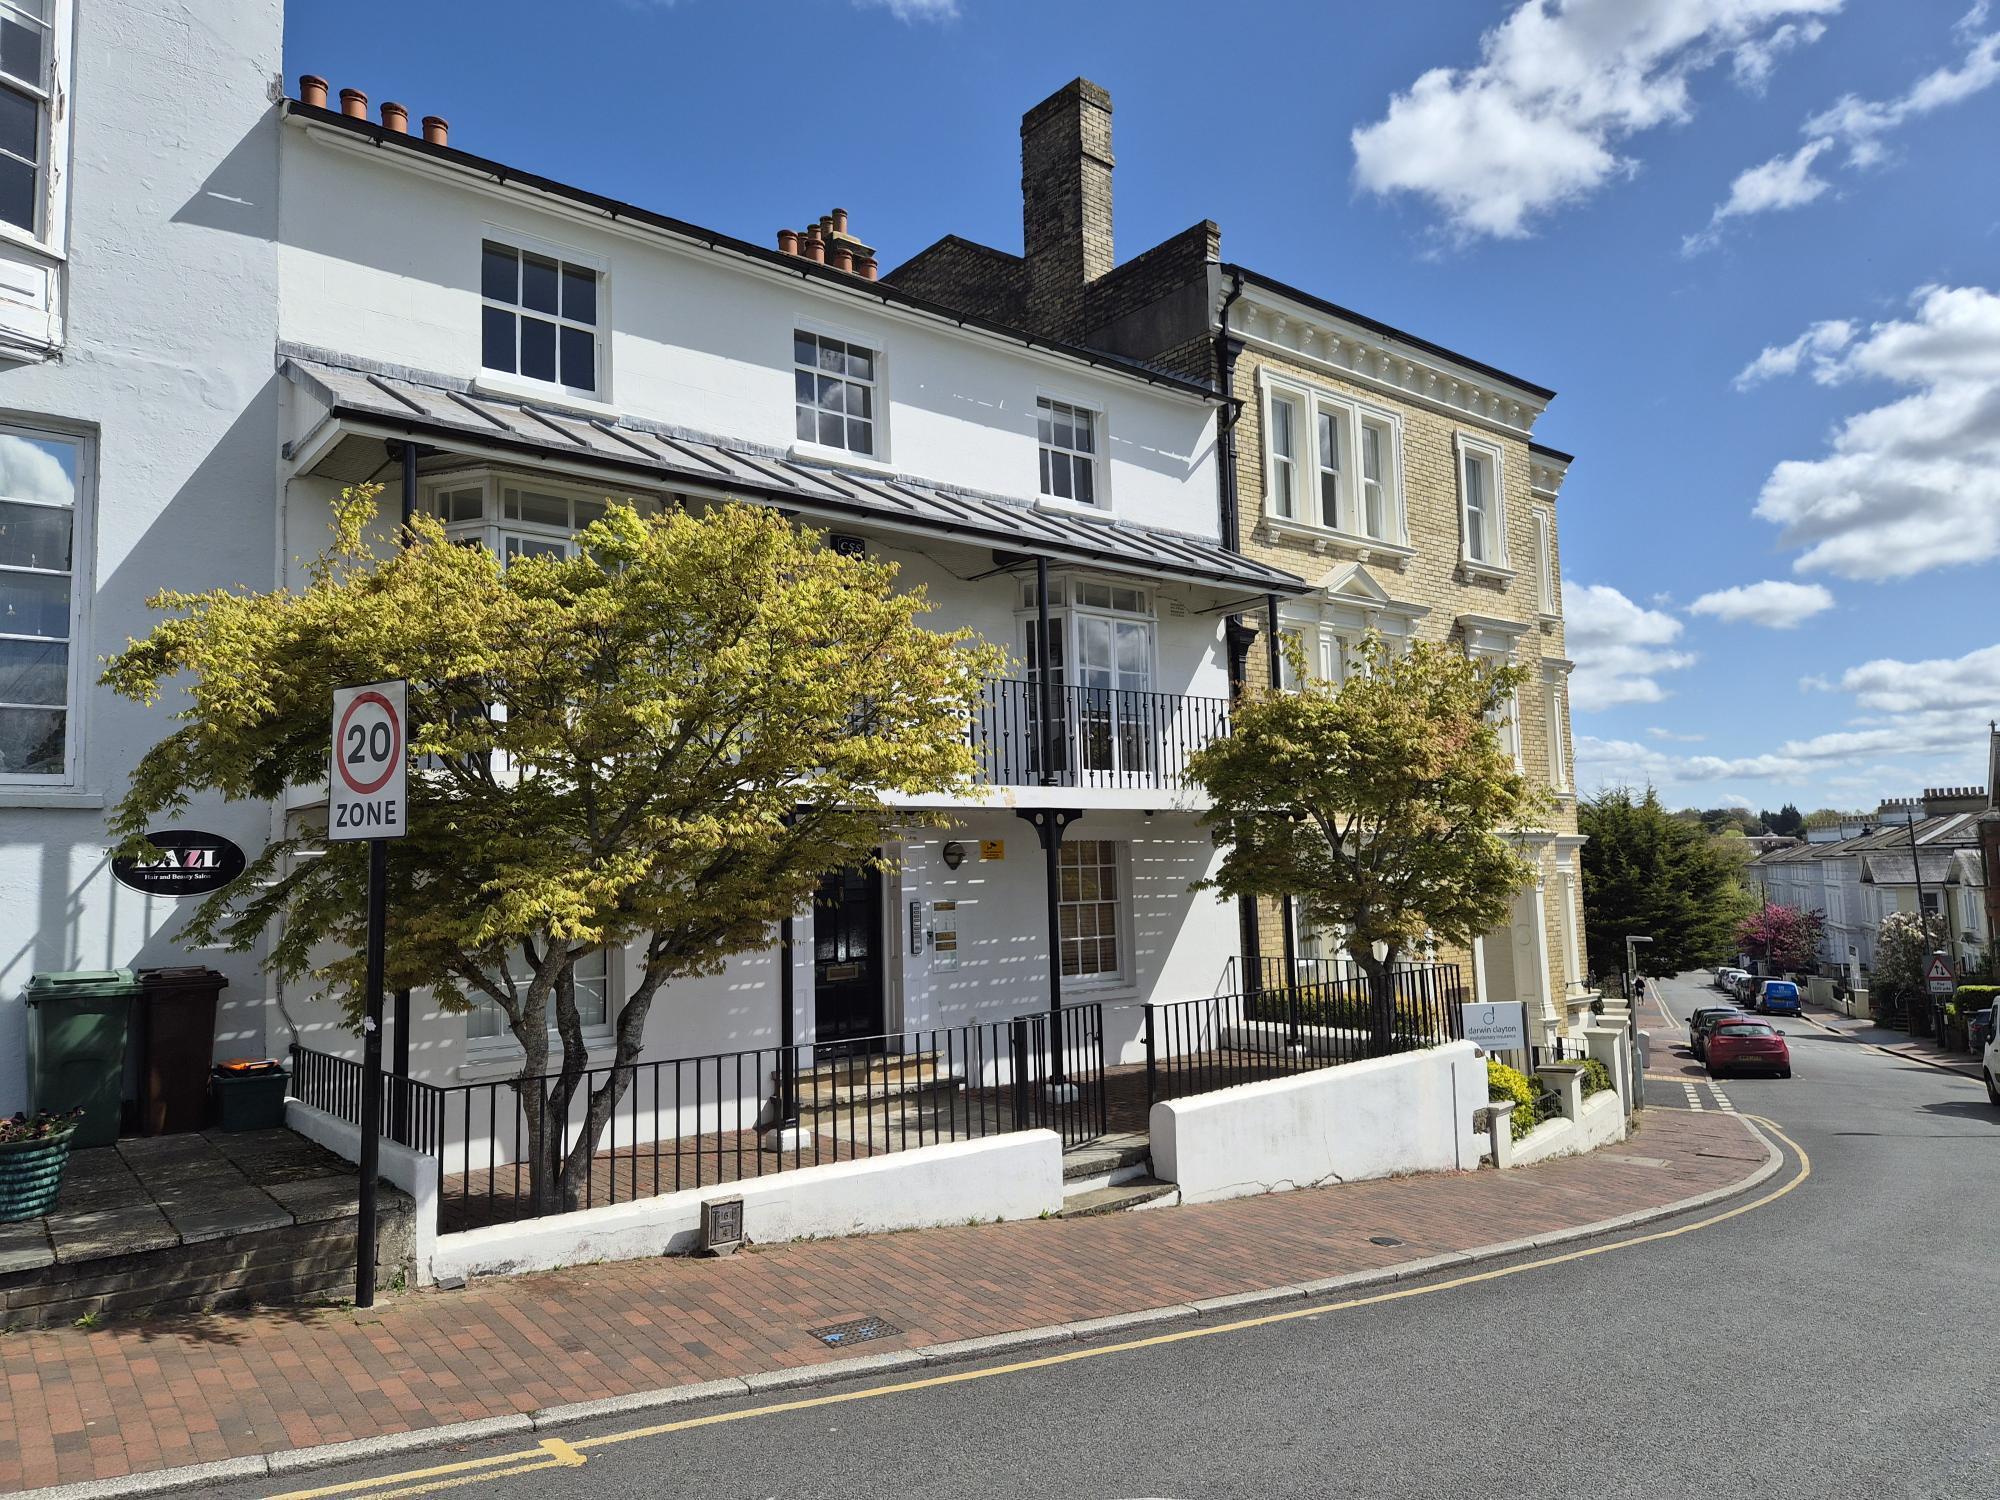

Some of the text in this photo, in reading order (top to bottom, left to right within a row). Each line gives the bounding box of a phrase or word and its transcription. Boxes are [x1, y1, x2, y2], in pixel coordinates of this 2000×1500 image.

[840, 541, 862, 552] CSS
[348, 721, 391, 764] 20
[336, 801, 396, 828] ZONE
[1468, 1025, 1517, 1035] darwin clayton
